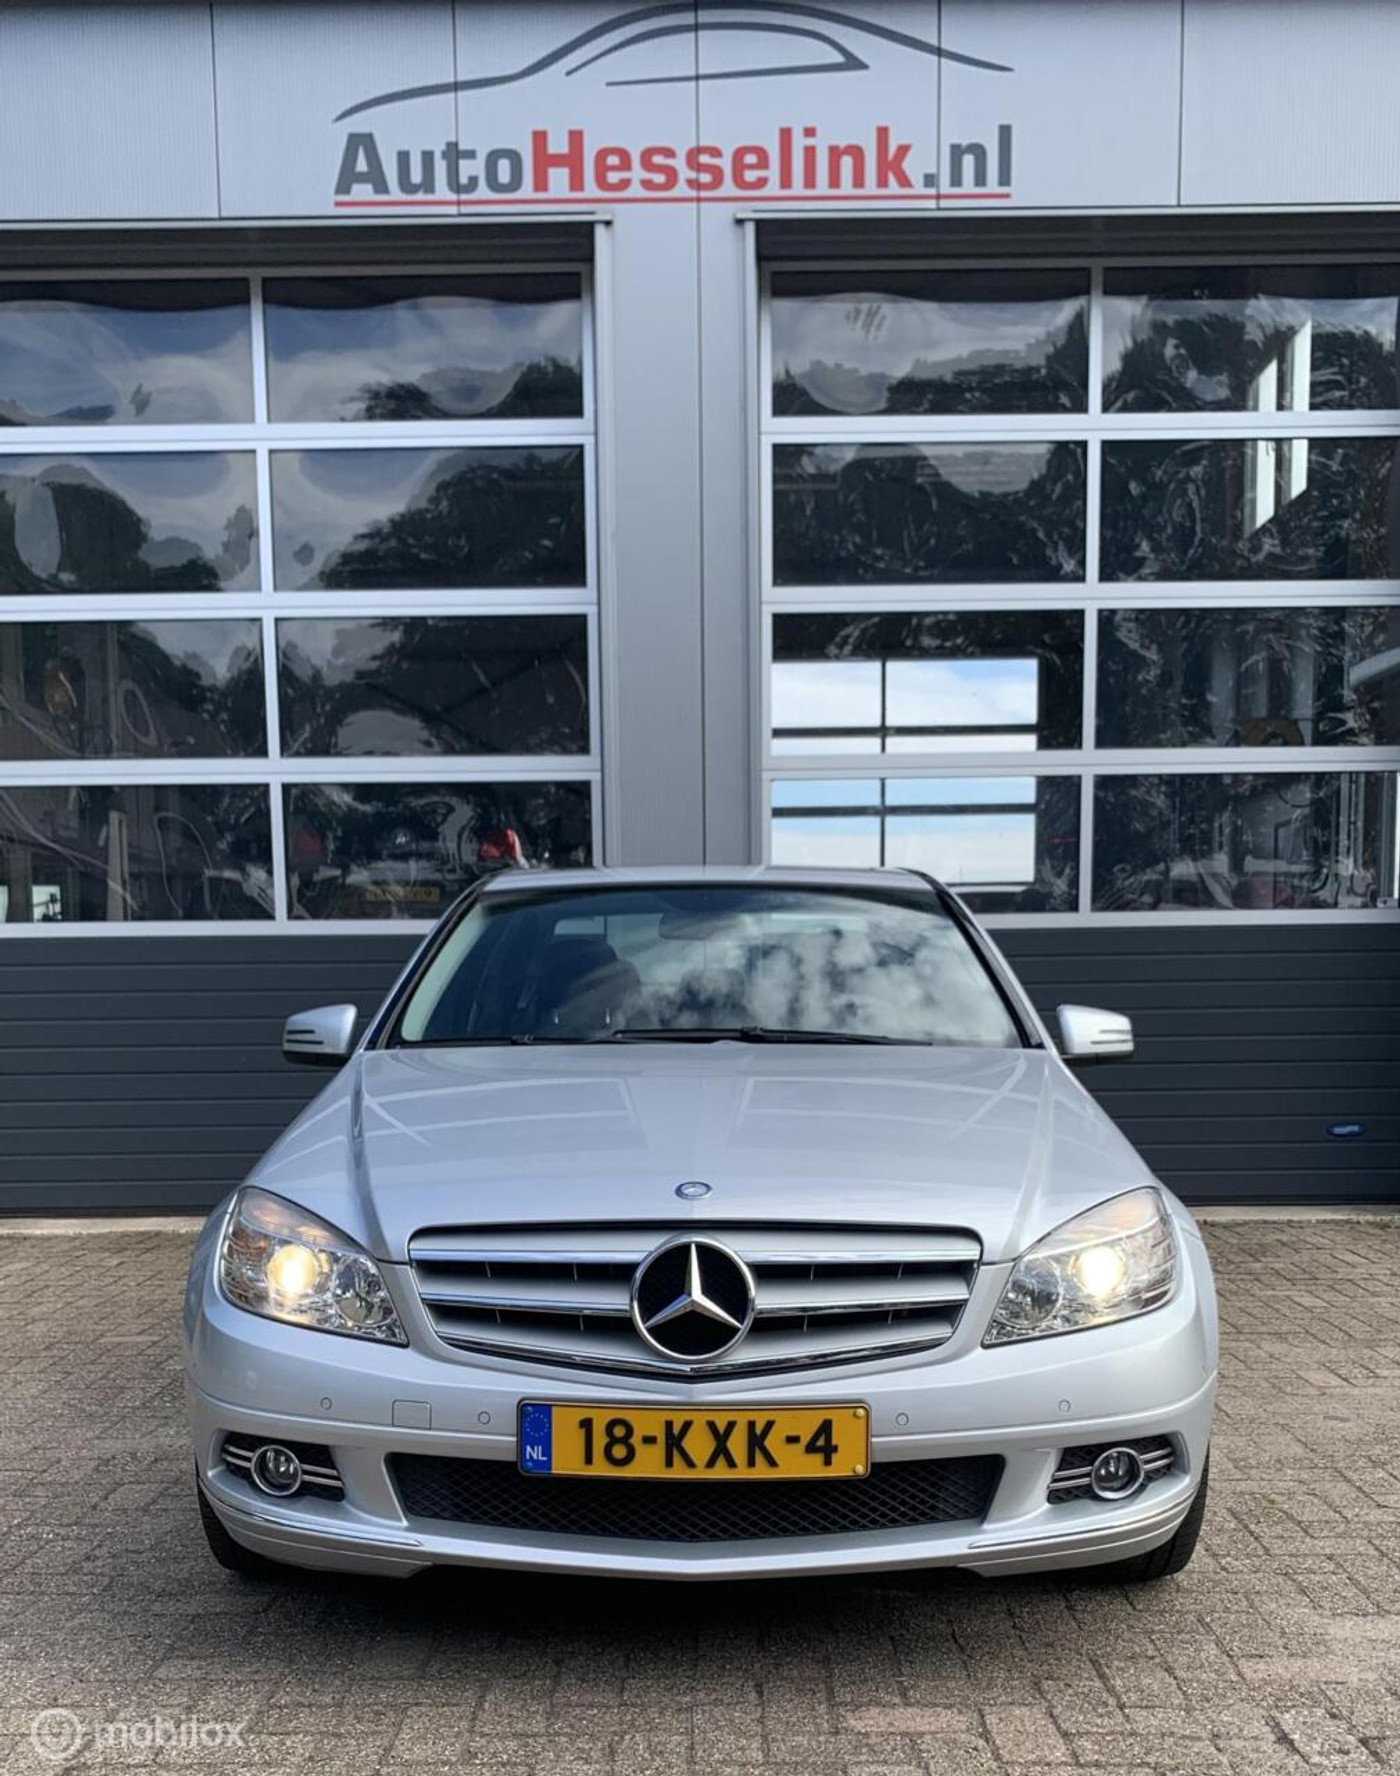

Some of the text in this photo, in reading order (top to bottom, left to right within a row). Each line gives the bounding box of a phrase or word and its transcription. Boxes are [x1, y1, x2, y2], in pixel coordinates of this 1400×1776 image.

[334, 124, 1012, 196] AutoHesselink.nl
[525, 1445, 548, 1460] NL
[578, 1416, 839, 1469] 18-KXK-4
